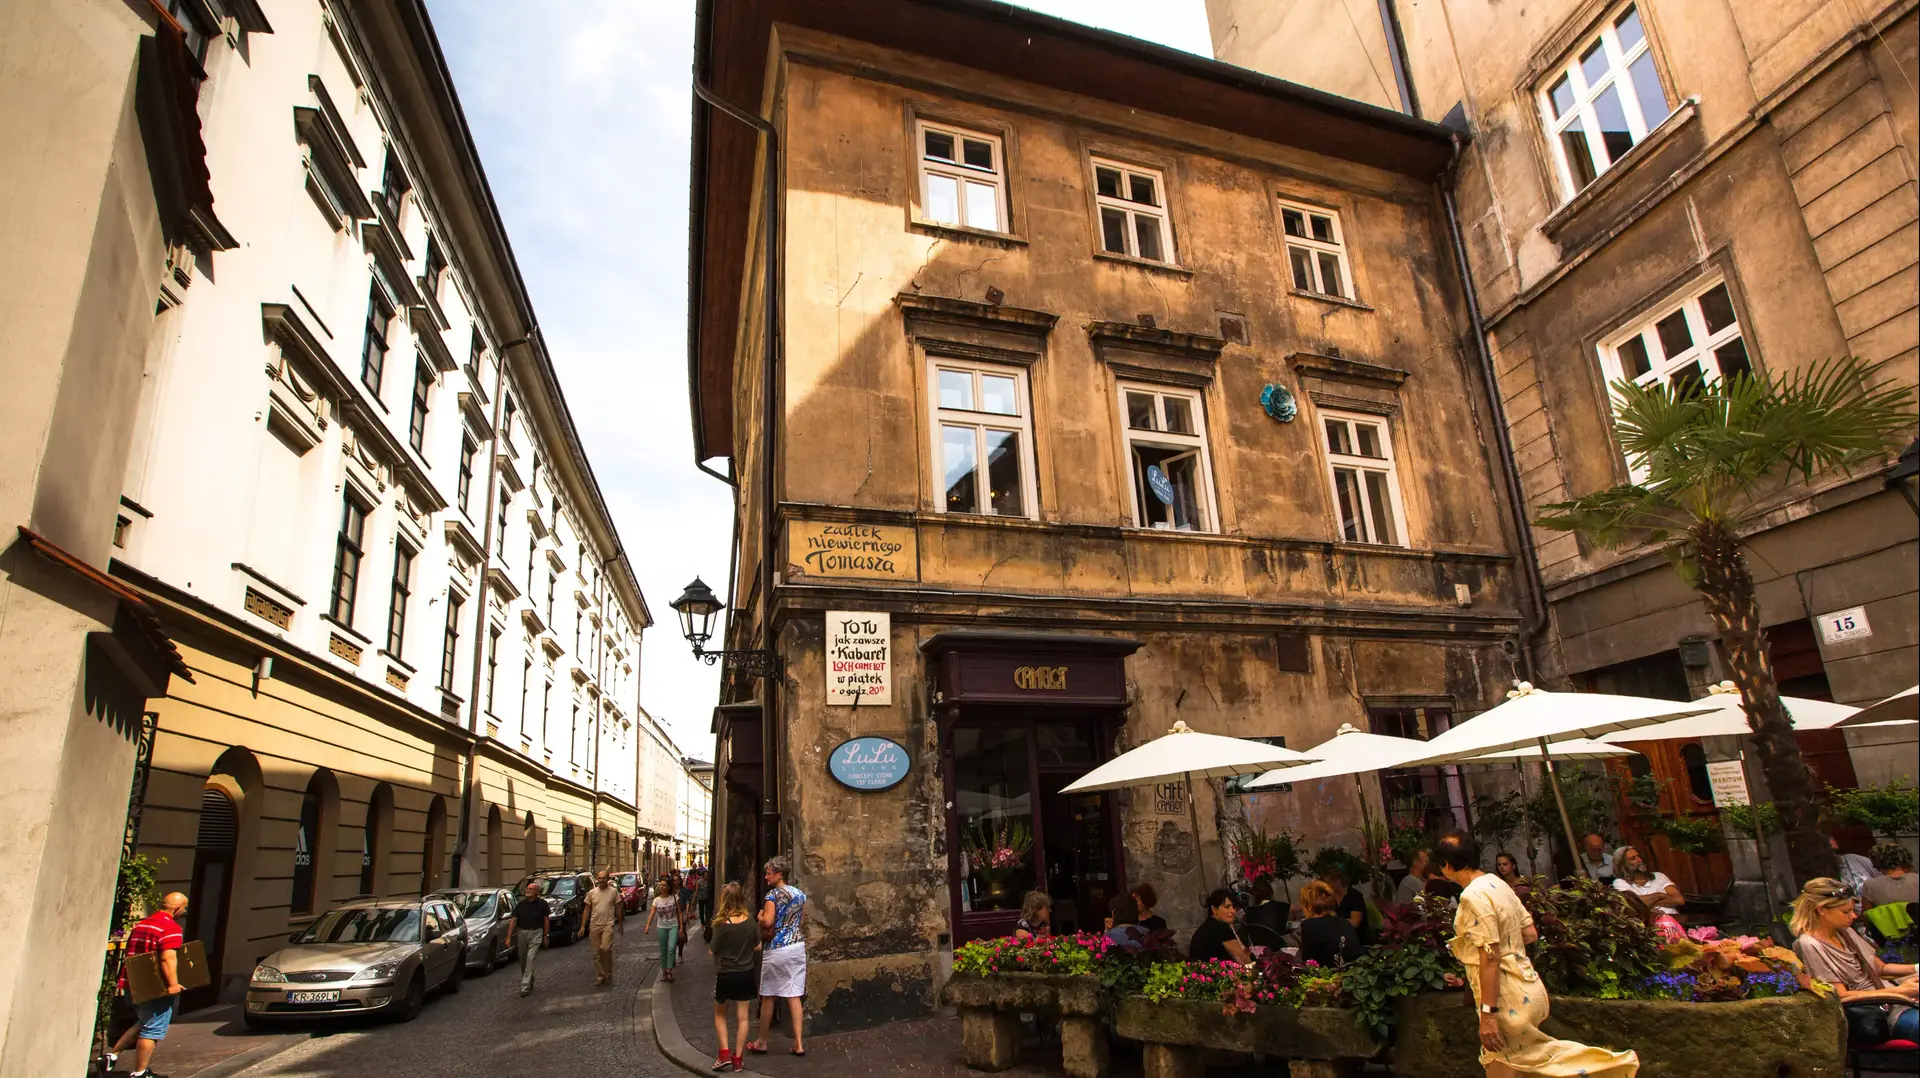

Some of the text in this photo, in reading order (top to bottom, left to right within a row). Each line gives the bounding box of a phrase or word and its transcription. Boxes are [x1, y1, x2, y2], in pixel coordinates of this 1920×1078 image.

[808, 535, 902, 556] niewiernego
[805, 550, 895, 574] Tomasza
[1833, 616, 1856, 633] 15
[835, 634, 851, 648] jak
[838, 646, 887, 661] Kabaret
[833, 661, 854, 672] LOCH
[837, 672, 883, 687] w piątek
[1014, 666, 1068, 690] CAMELOT
